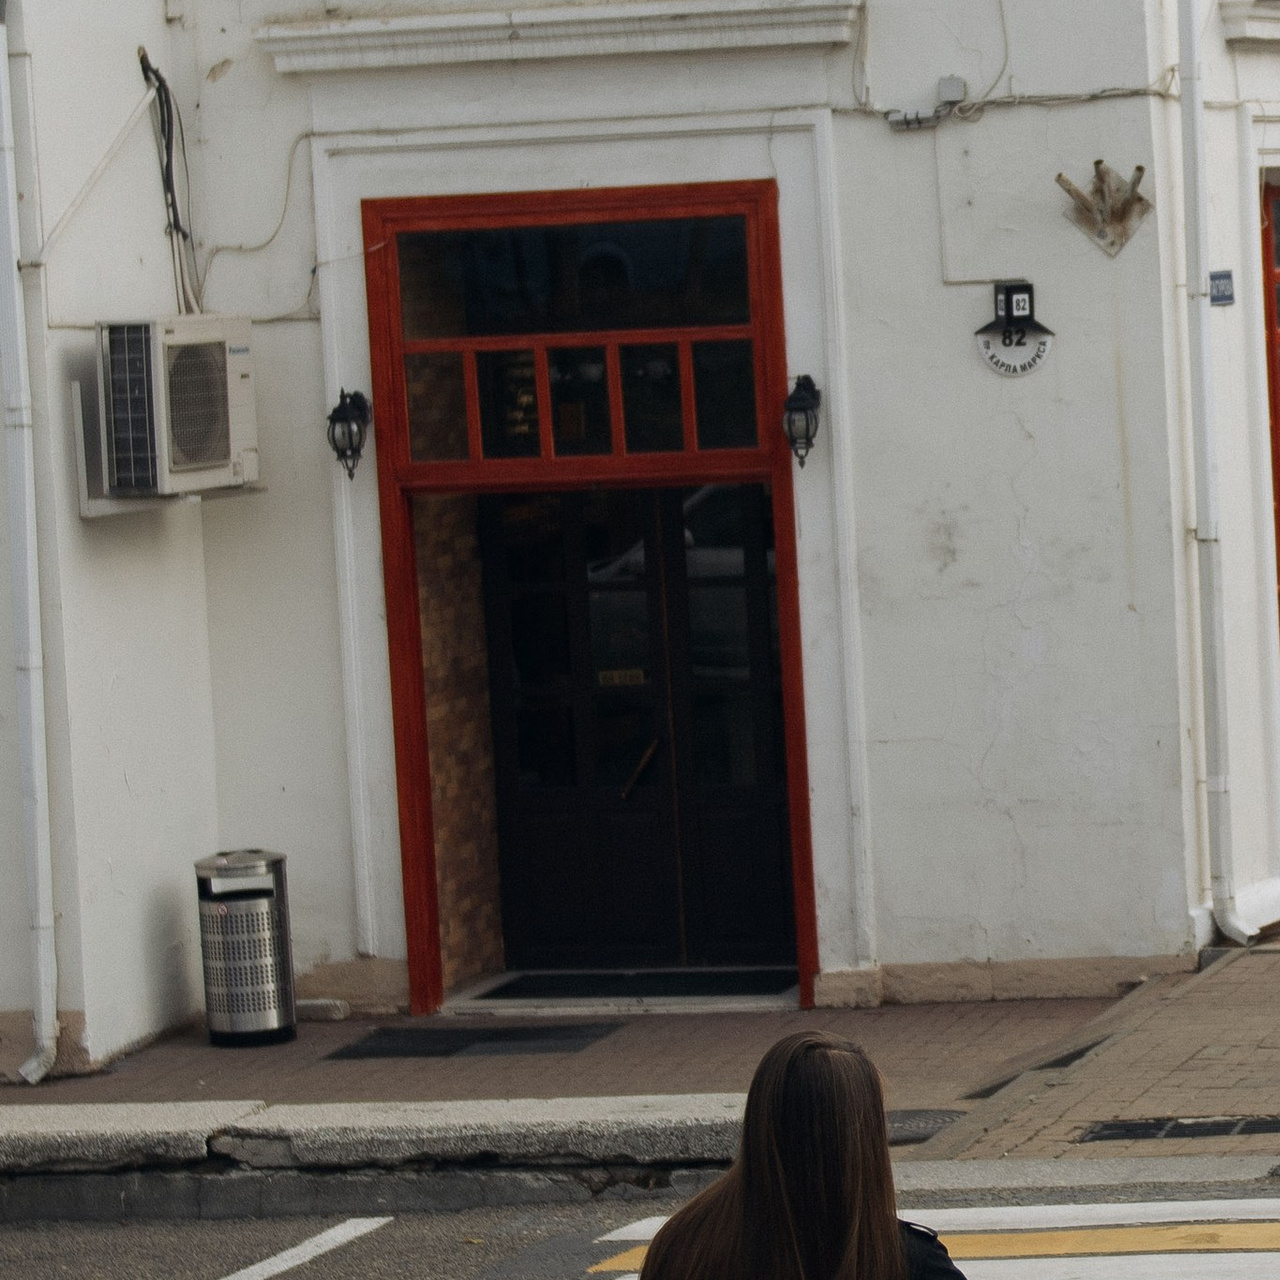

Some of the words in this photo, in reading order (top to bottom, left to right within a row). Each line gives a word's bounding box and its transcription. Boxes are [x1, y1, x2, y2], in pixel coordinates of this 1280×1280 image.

[1015, 298, 1027, 311] 82
[1001, 328, 1027, 347] 82
[988, 353, 1018, 373] КАРЛА
[1020, 340, 1048, 372] МАРКСА
